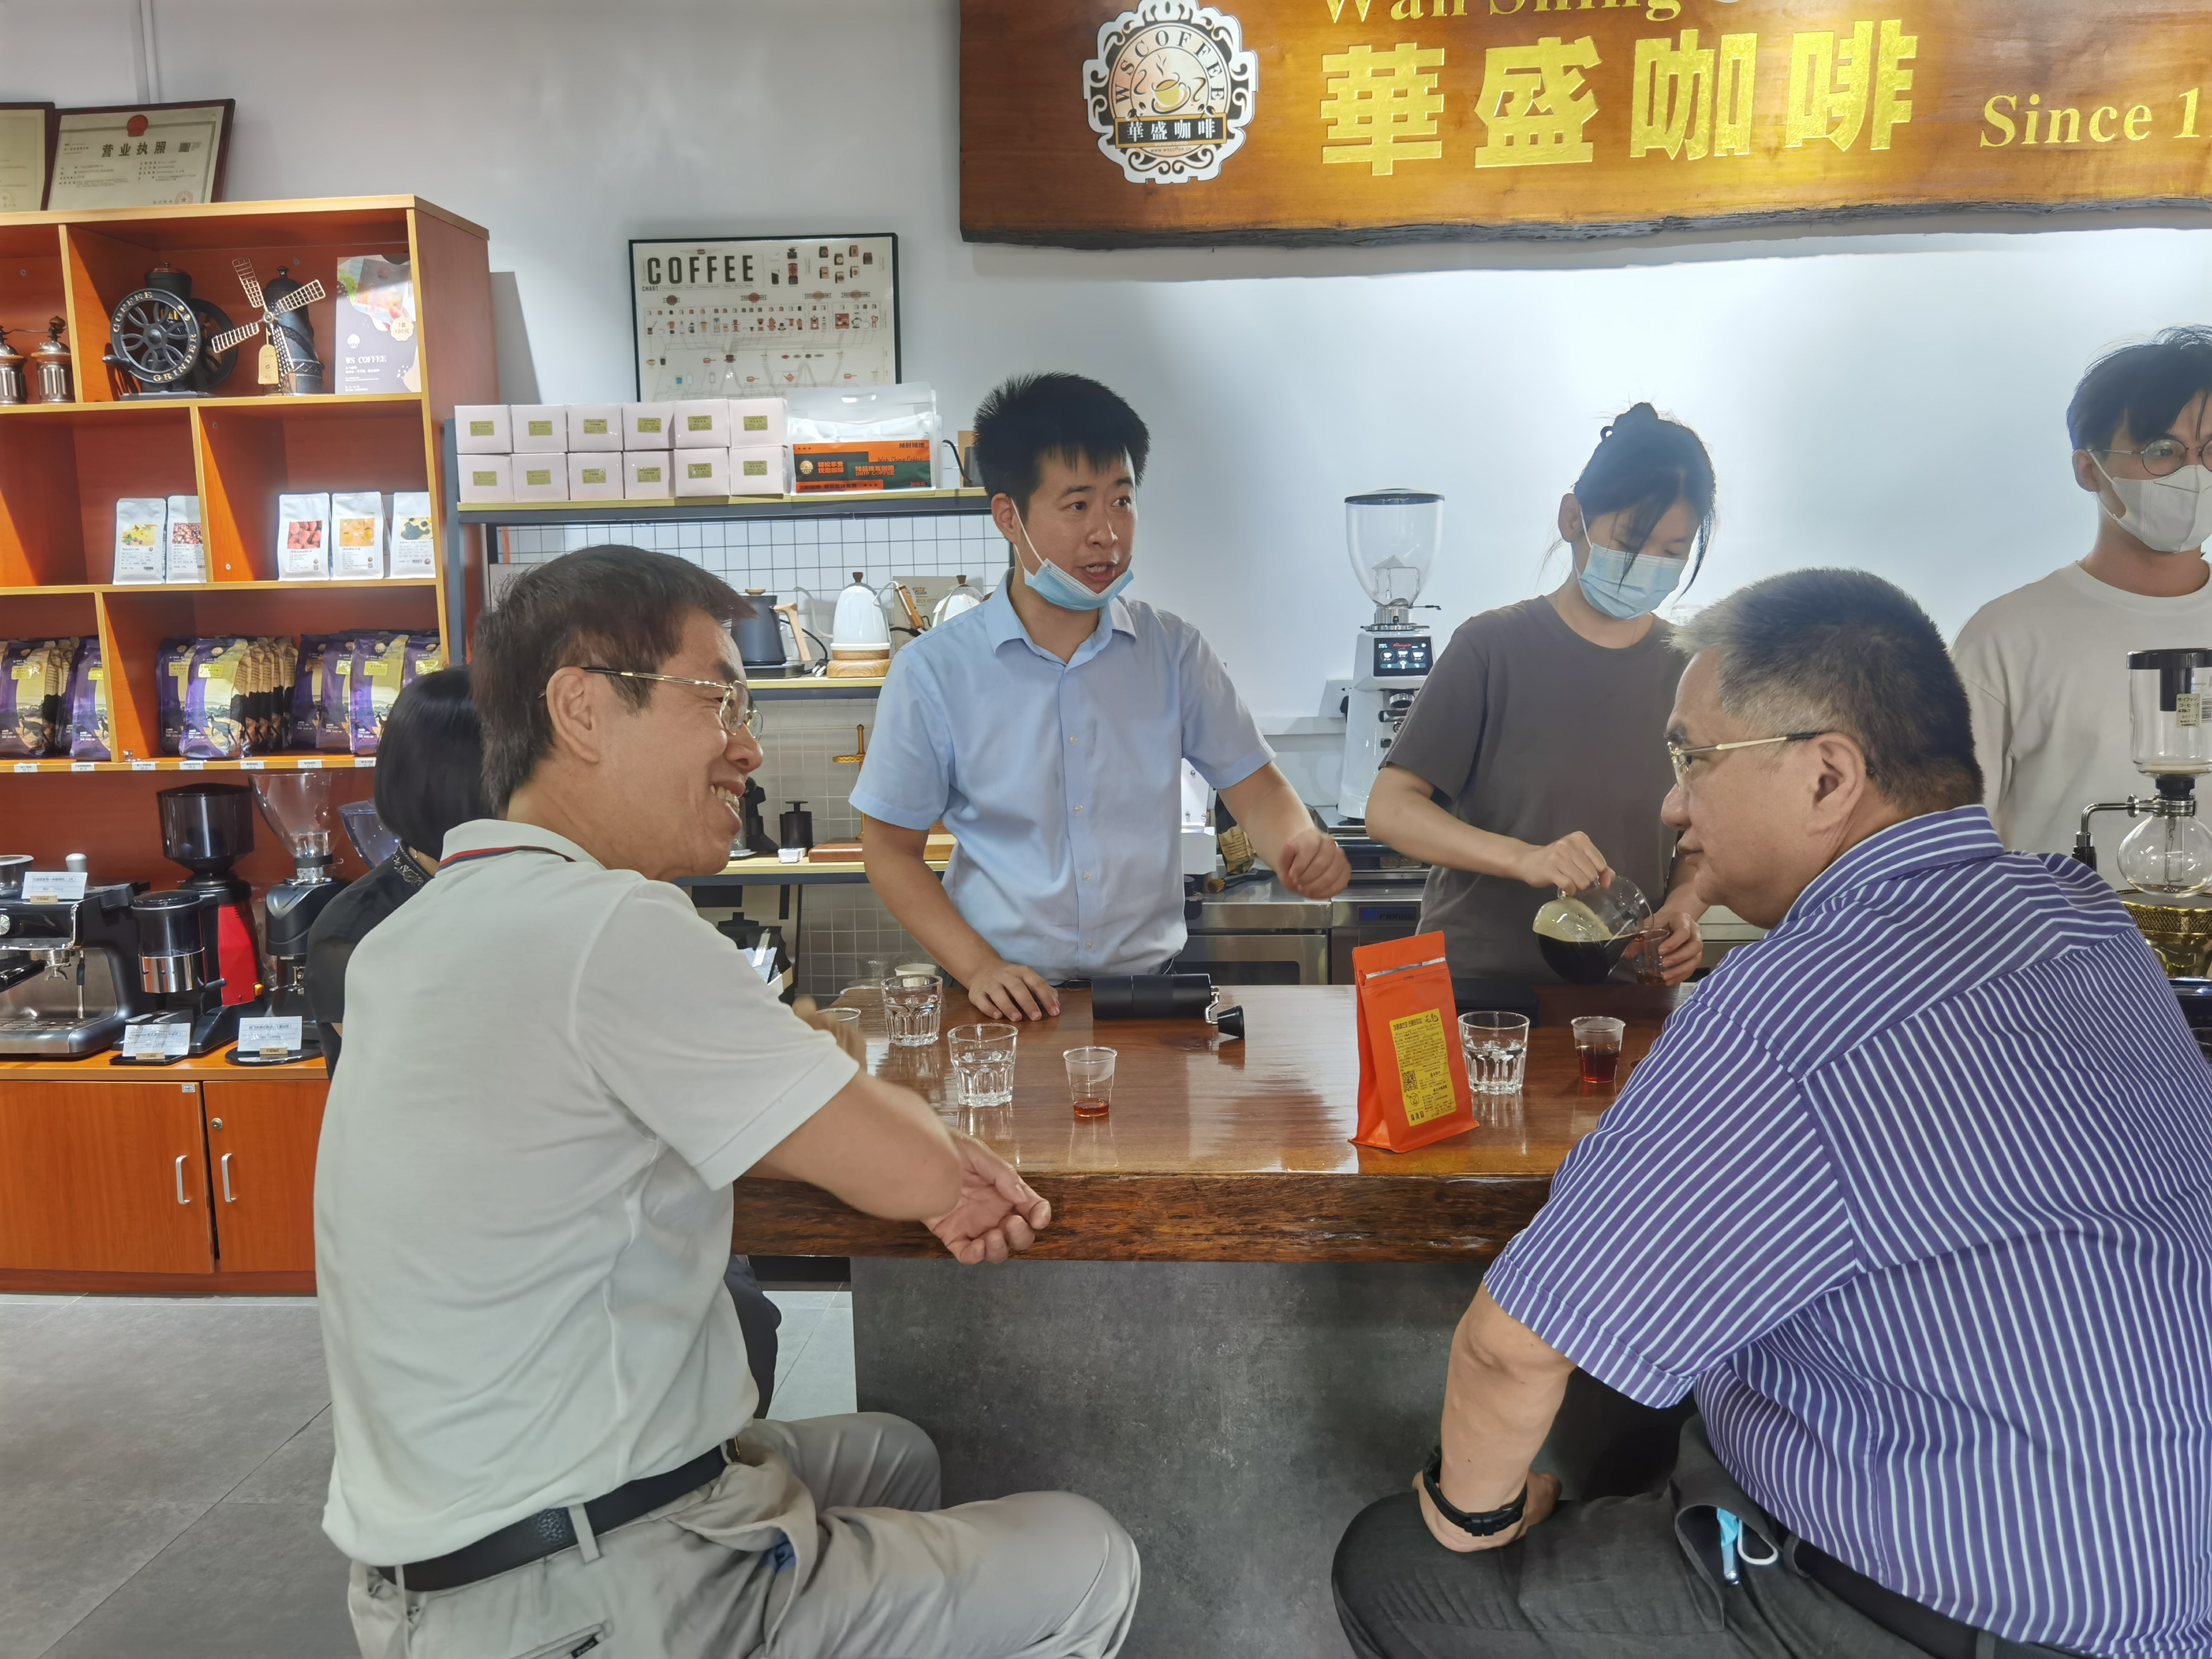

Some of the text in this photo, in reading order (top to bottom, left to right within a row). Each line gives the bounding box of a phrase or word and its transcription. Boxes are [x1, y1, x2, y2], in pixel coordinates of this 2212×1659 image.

[1321, 19, 1918, 176] 華盛咖啡
[1127, 118, 1216, 142] 華盛咖啡
[1980, 87, 2212, 149] Since 1
[102, 141, 167, 158] 营业执照
[647, 255, 754, 285] COFFEE
[113, 291, 153, 333] COFFEE
[153, 333, 197, 382] GRINDER
[358, 355, 387, 363] COFFEE
